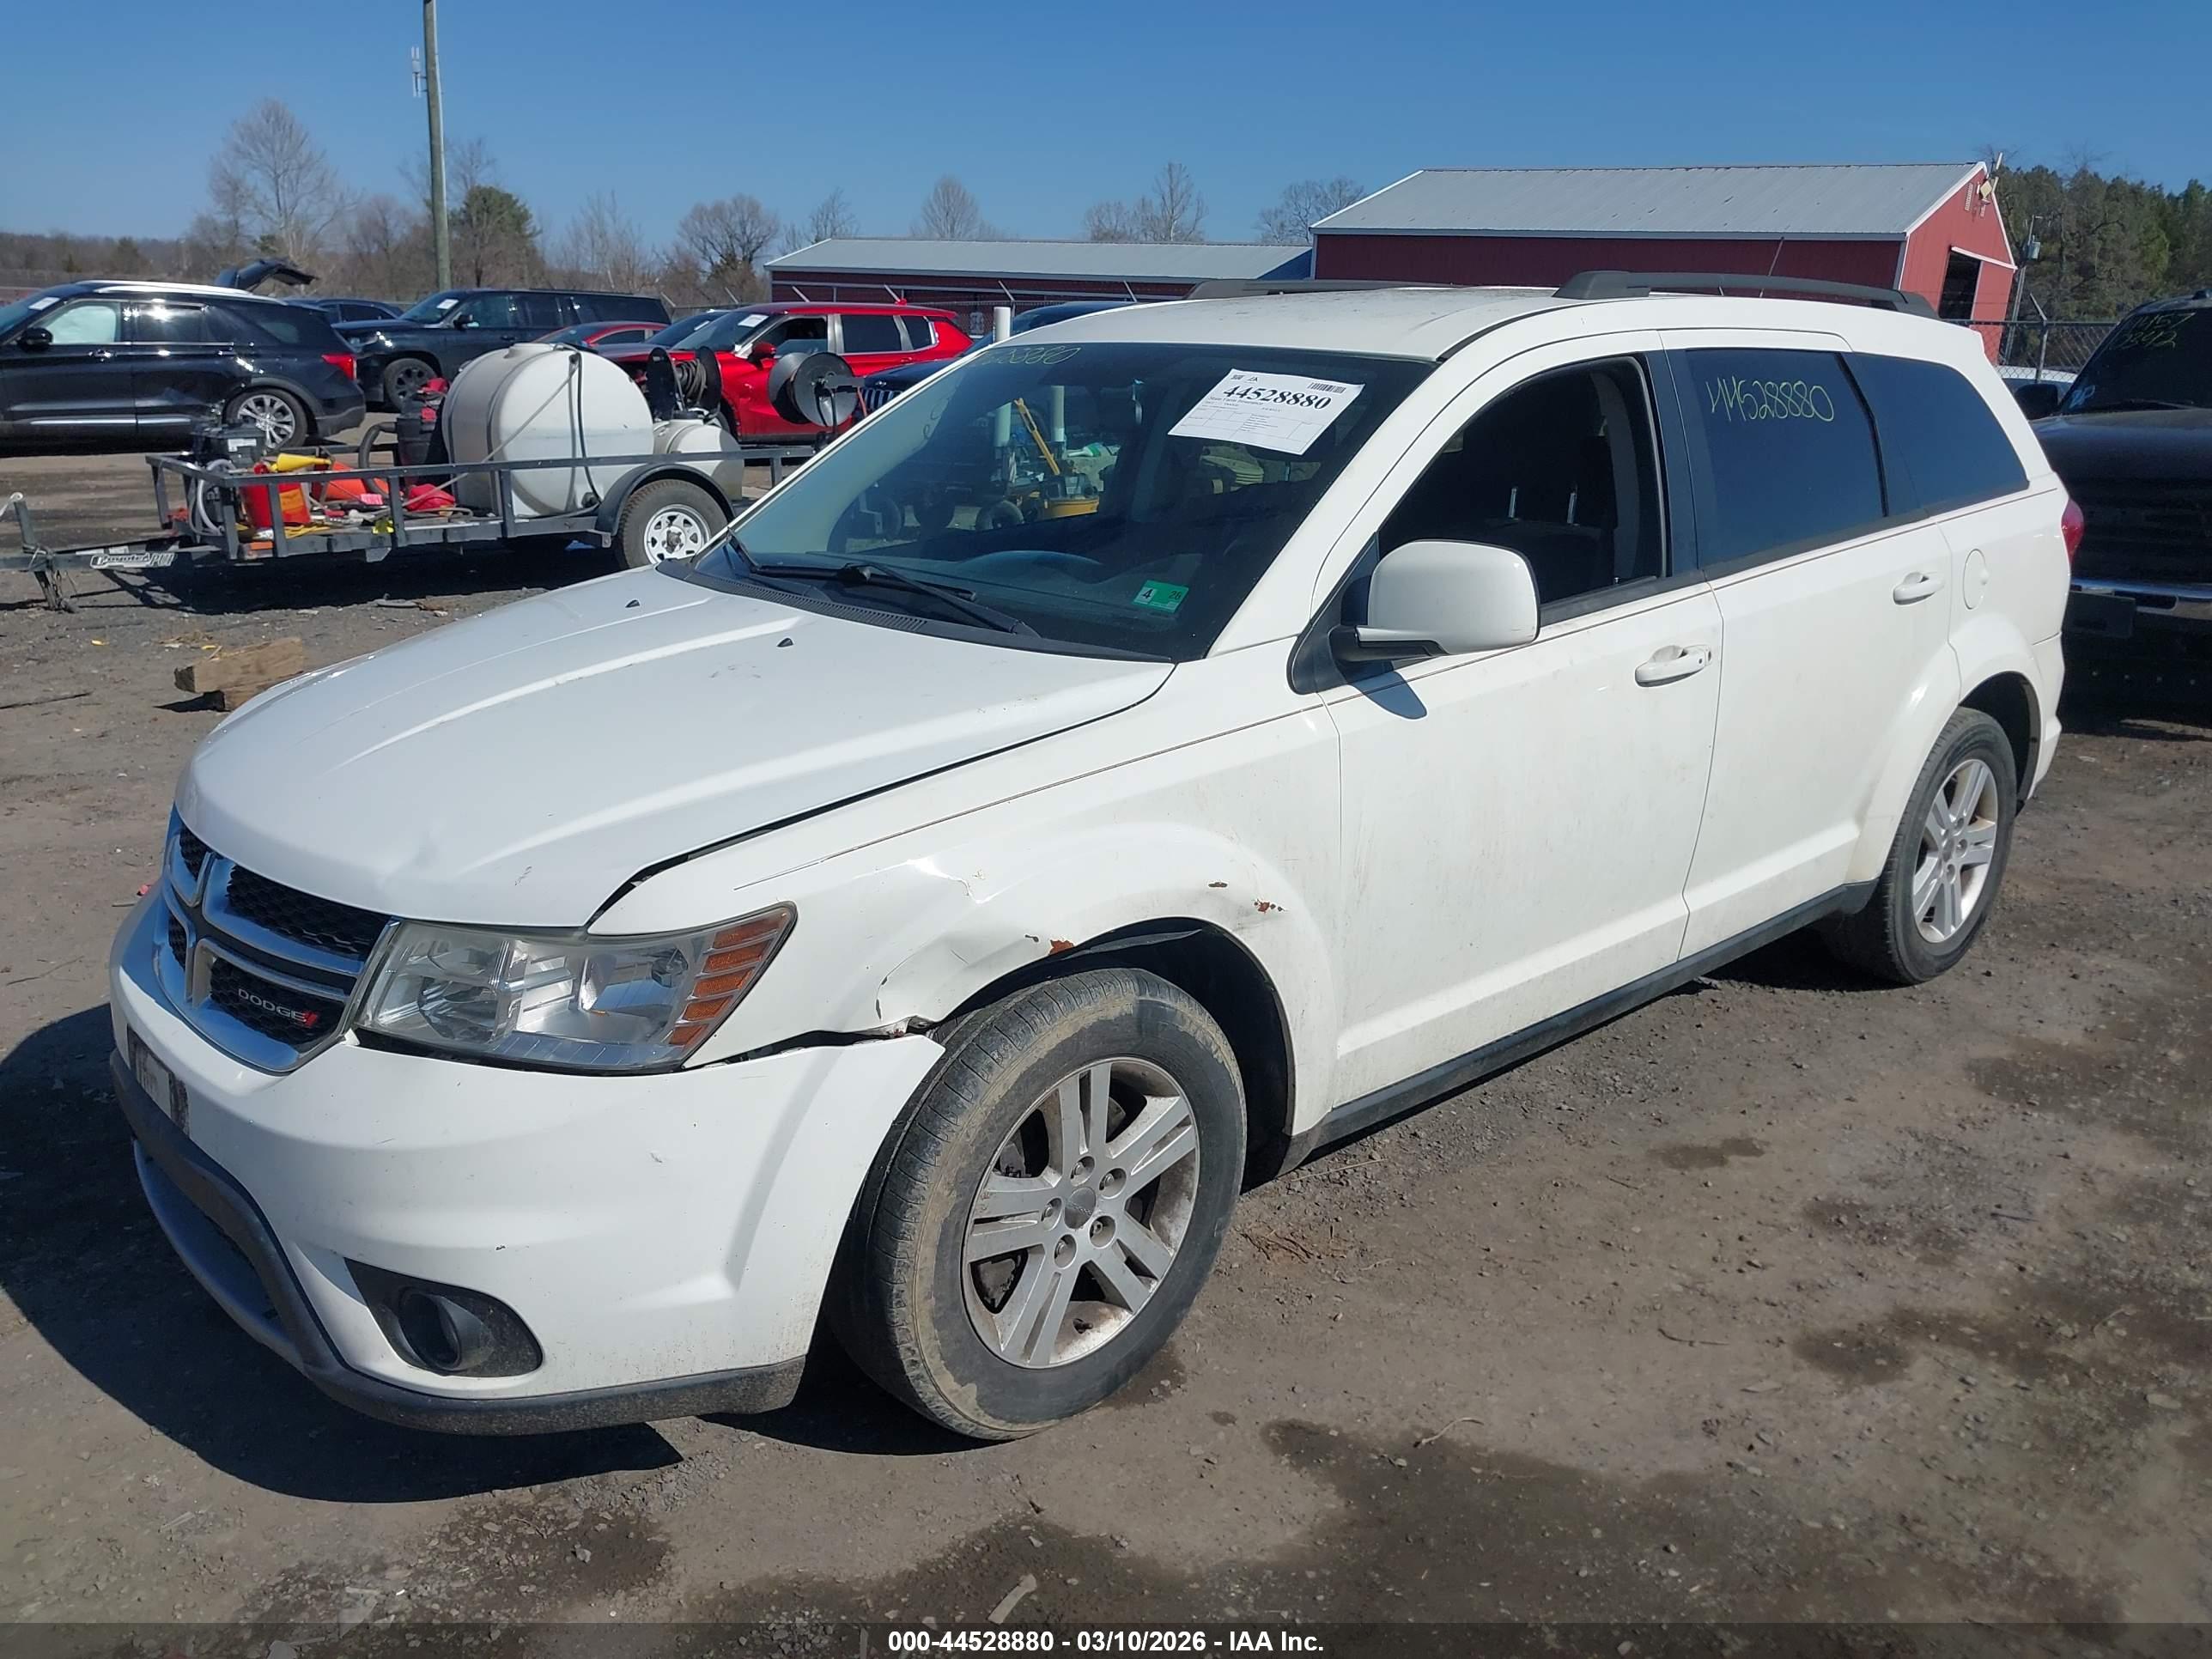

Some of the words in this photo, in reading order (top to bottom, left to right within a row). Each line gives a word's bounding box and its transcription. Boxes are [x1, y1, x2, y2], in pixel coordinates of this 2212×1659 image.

[1223, 385, 1332, 410] 44528880
[1705, 375, 1834, 422] 44528880
[1141, 588, 1153, 599] 4
[238, 988, 307, 1023] DODGE
